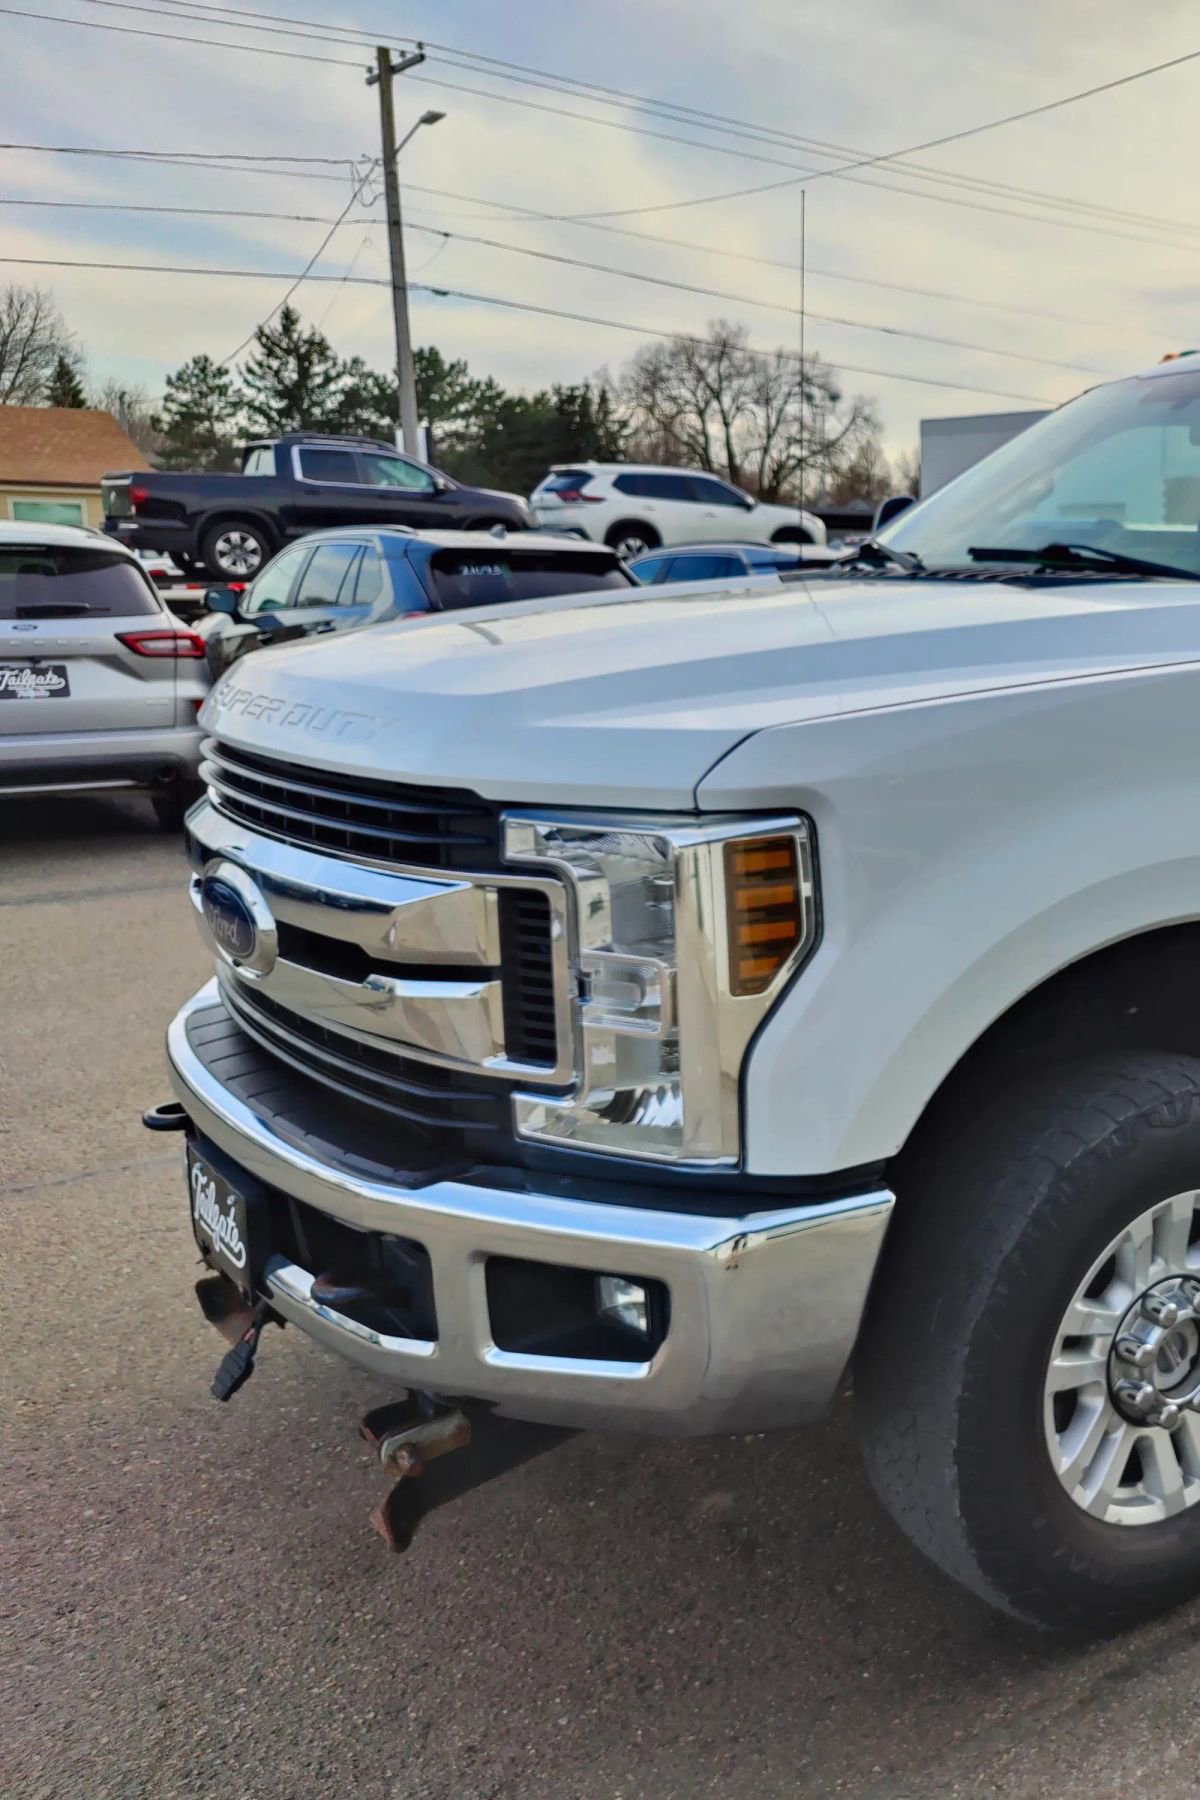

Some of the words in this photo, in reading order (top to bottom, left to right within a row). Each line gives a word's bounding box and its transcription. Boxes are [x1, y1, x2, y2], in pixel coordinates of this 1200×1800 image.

[0, 668, 66, 691] Tailgate
[212, 683, 286, 724] SUPER
[279, 702, 401, 741] DUTY
[191, 1162, 247, 1269] Tailgate
